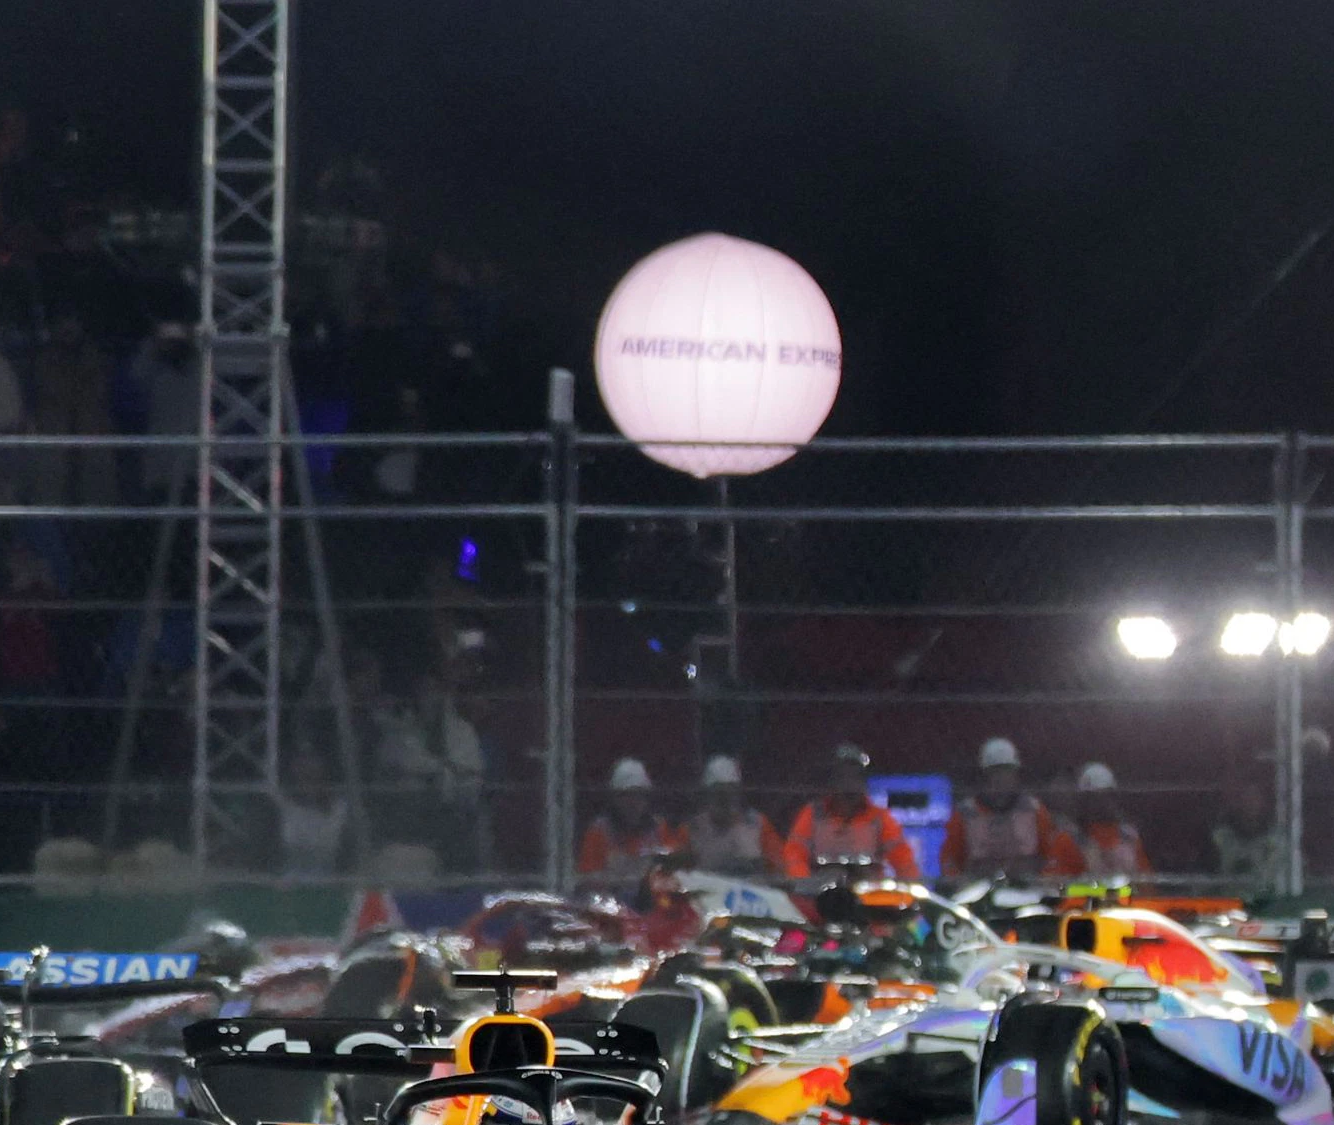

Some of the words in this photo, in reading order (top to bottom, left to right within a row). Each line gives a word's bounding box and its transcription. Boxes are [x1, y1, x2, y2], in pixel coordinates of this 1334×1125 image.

[621, 337, 766, 363] AMERICAN
[778, 344, 841, 370] EXPR
[1239, 1022, 1306, 1101] VISA
